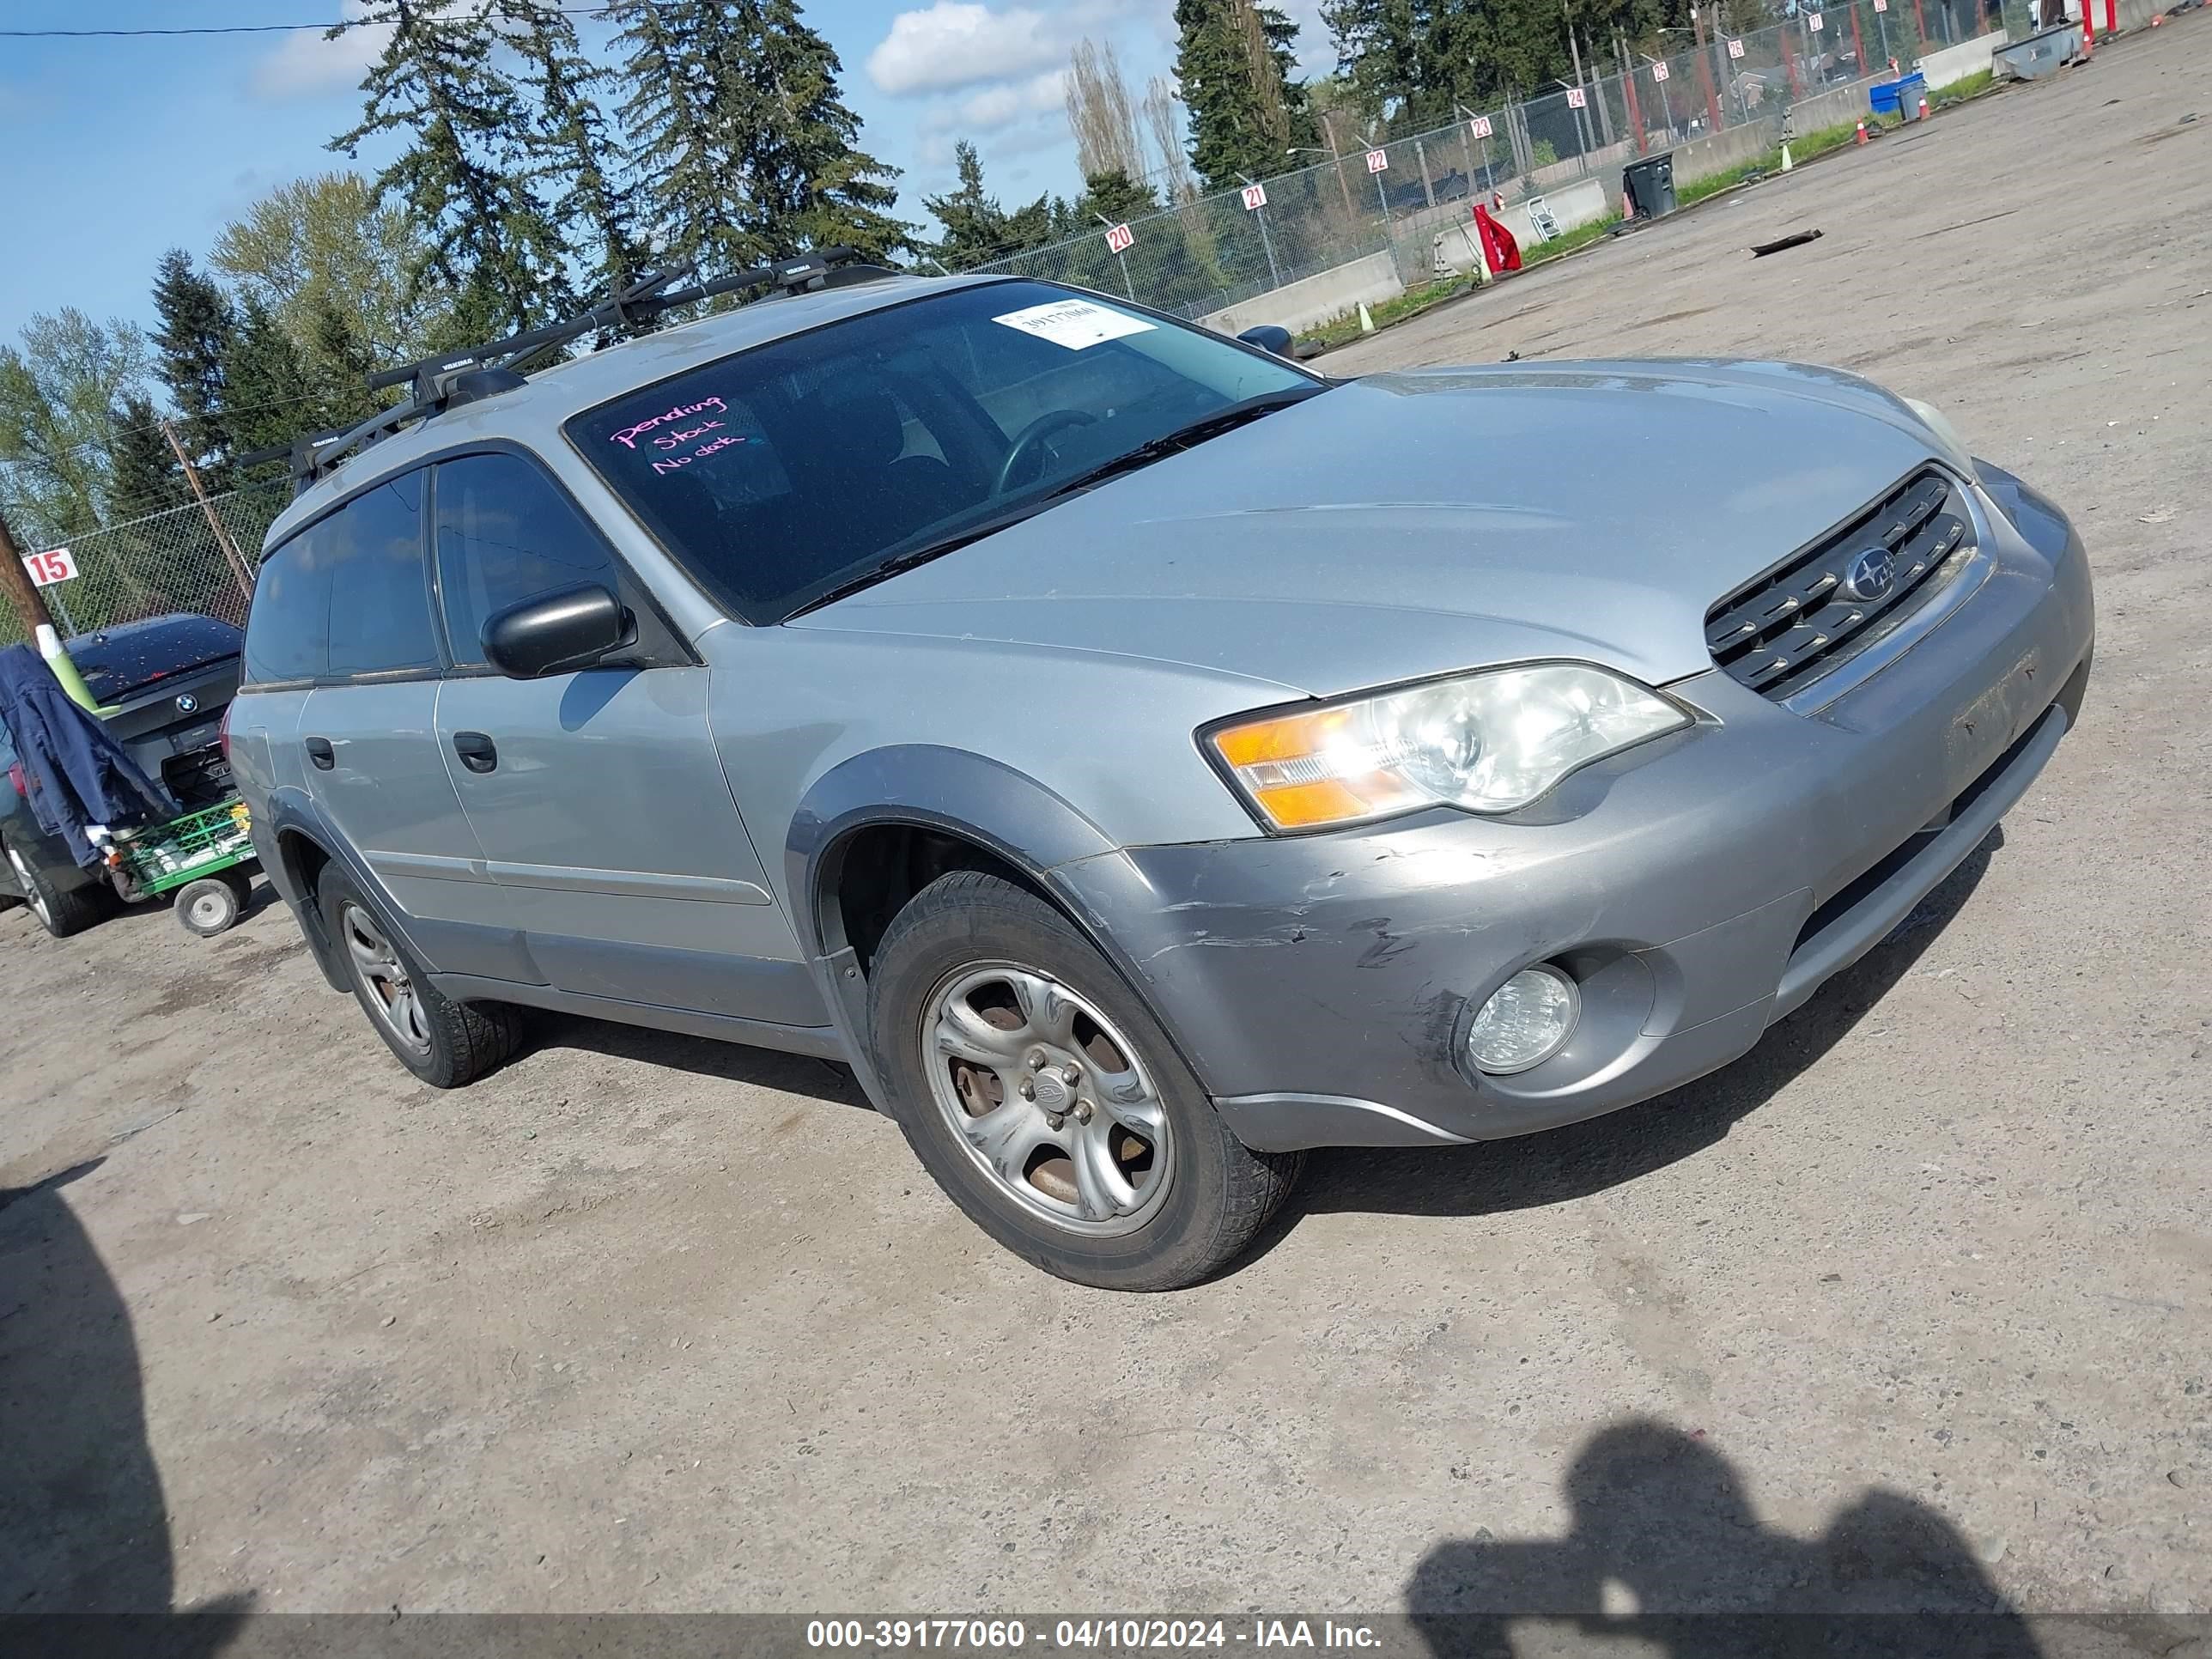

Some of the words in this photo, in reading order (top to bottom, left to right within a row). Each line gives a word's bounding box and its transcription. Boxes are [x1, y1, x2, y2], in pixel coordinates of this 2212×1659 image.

[1811, 15, 1820, 30] 27
[1730, 42, 1742, 57] 26
[1654, 64, 1667, 80] 25
[1569, 90, 1583, 106] 24
[1474, 118, 1489, 137] 23
[1369, 151, 1385, 171] 22
[1246, 186, 1262, 207] 21
[1109, 227, 1130, 250] 20
[441, 357, 474, 371] YAKIMA
[651, 456, 692, 476] No
[29, 551, 69, 583] 15
